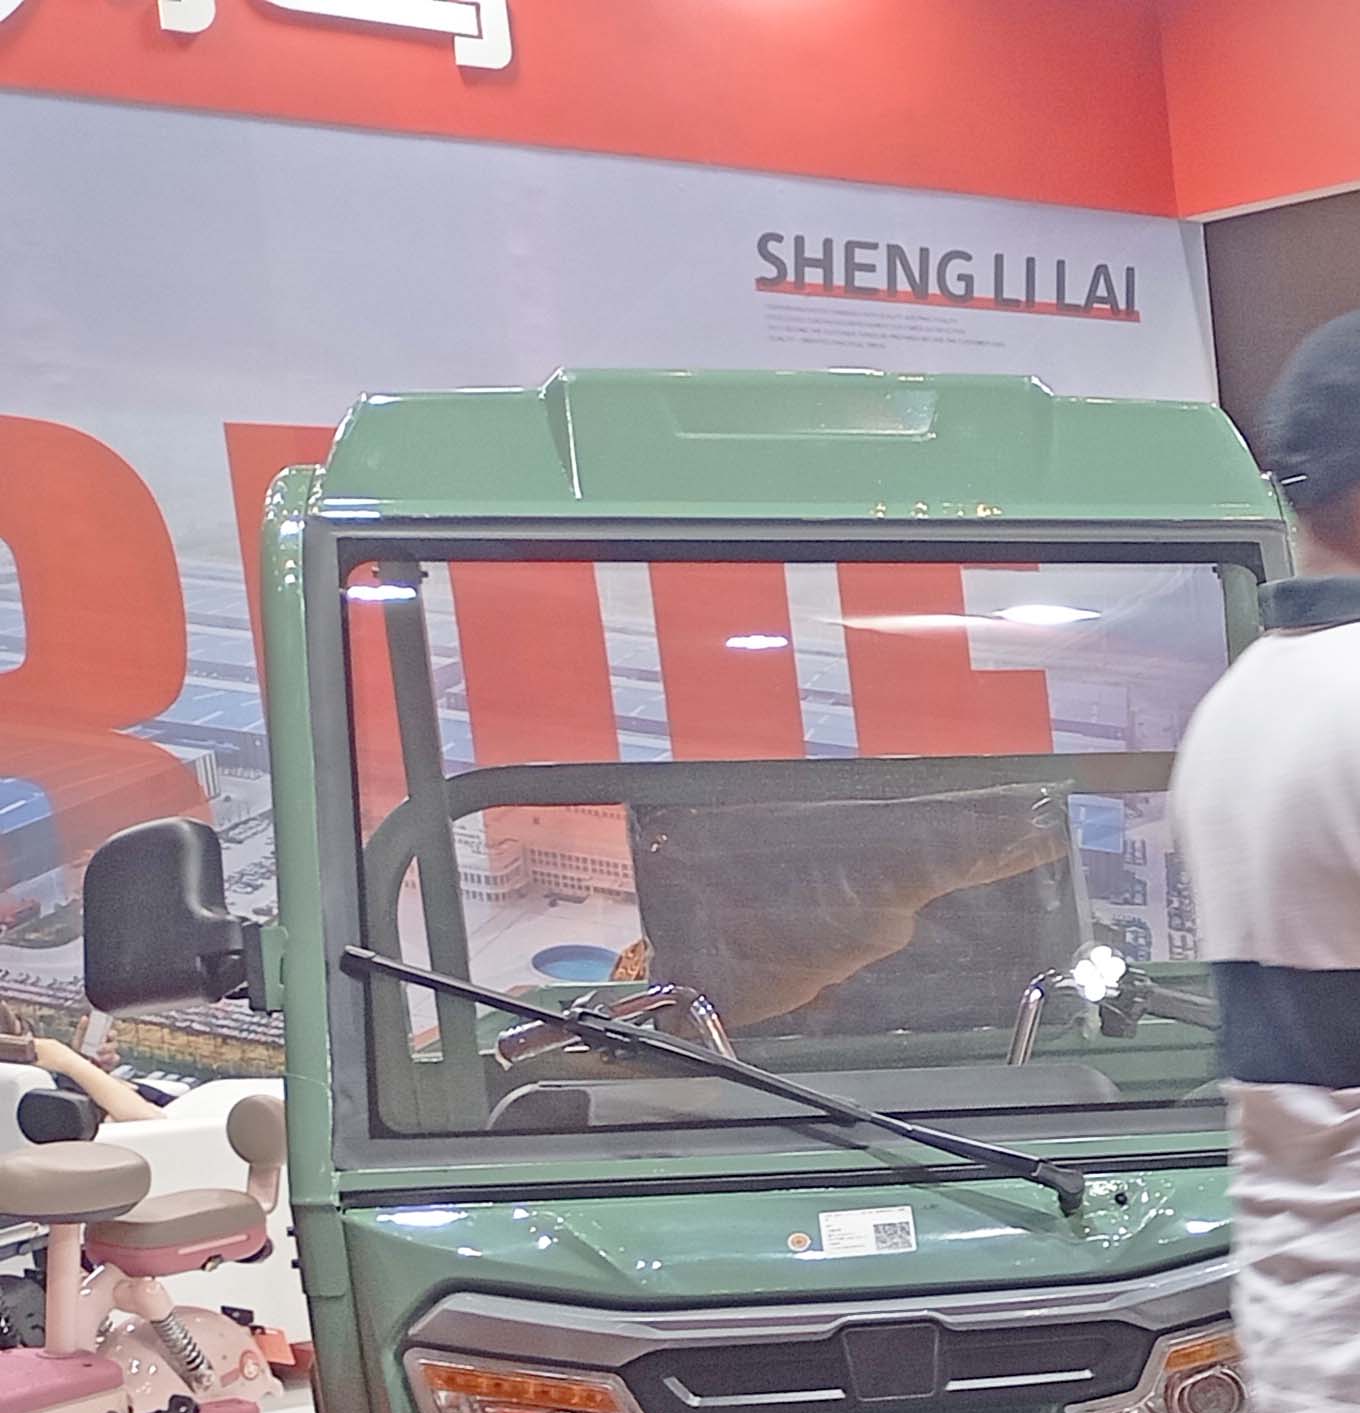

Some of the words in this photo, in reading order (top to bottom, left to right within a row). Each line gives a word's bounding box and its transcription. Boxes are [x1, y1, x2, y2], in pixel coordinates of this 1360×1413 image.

[756, 232, 974, 304] SHENG
[995, 253, 1036, 308] LI
[1056, 259, 1135, 315] LAI
